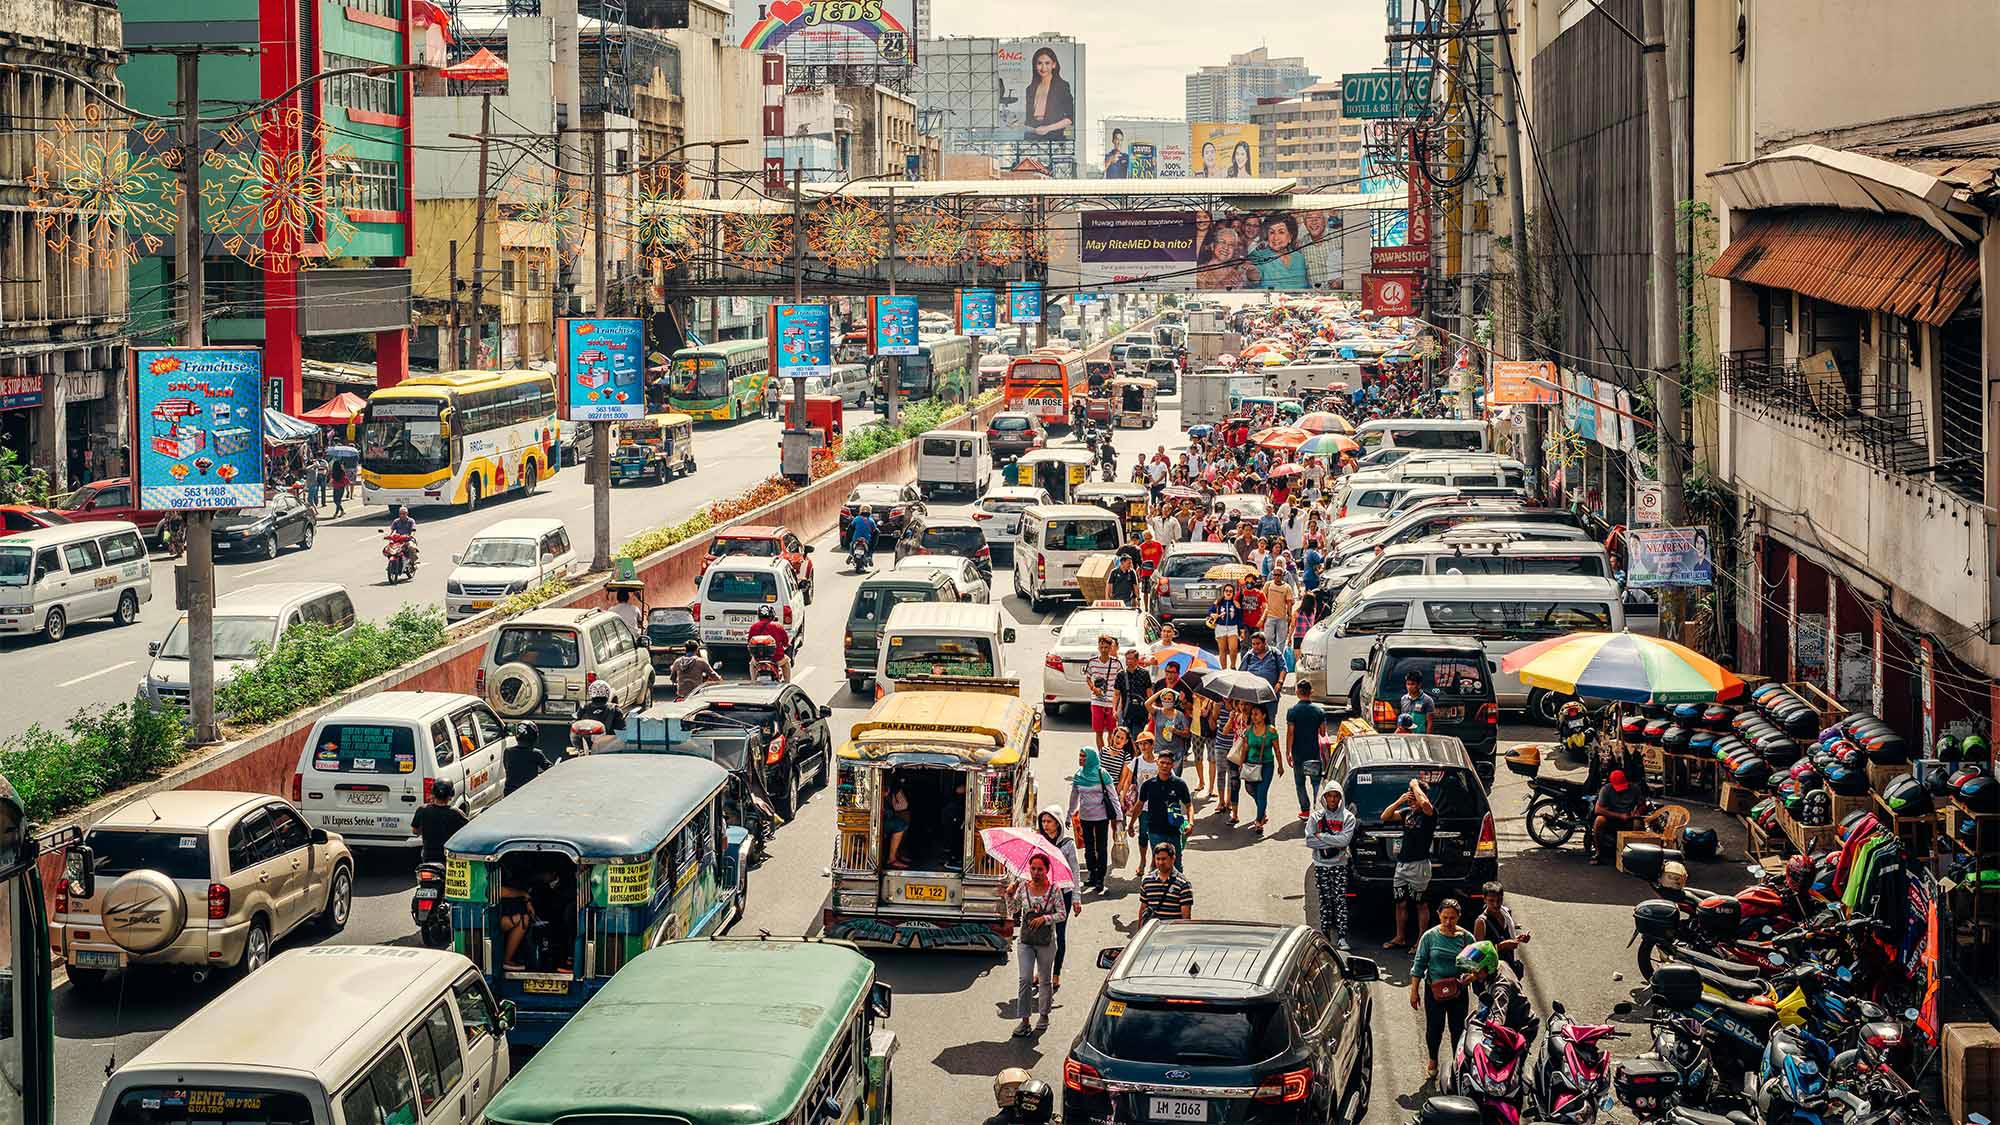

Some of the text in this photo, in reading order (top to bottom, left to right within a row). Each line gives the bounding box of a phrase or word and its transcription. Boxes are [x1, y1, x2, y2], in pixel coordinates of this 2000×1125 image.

[758, 0, 883, 26] I JED'S
[883, 39, 905, 52] 24
[1346, 104, 1372, 113] HOTEL
[1086, 239, 1192, 251] May RiteMED ba nito?
[1373, 251, 1430, 264] PAWNSHOP
[183, 360, 246, 373] Franchise
[8, 377, 21, 394] STOP
[21, 375, 42, 393] BICYCLE
[1028, 398, 1062, 406] MA ROSE
[184, 487, 226, 497] 563 1408
[171, 498, 193, 508] 0927
[214, 496, 237, 507] 8000
[1646, 542, 1691, 552] NAZARENO
[880, 722, 974, 733] SAN ANTONIO SPURS
[332, 815, 353, 827] Express
[354, 816, 375, 827] Service
[610, 885, 624, 893] TEXT
[929, 887, 943, 896] 122
[189, 1090, 225, 1105] BENTE
[188, 1105, 224, 1113] QUATRO
